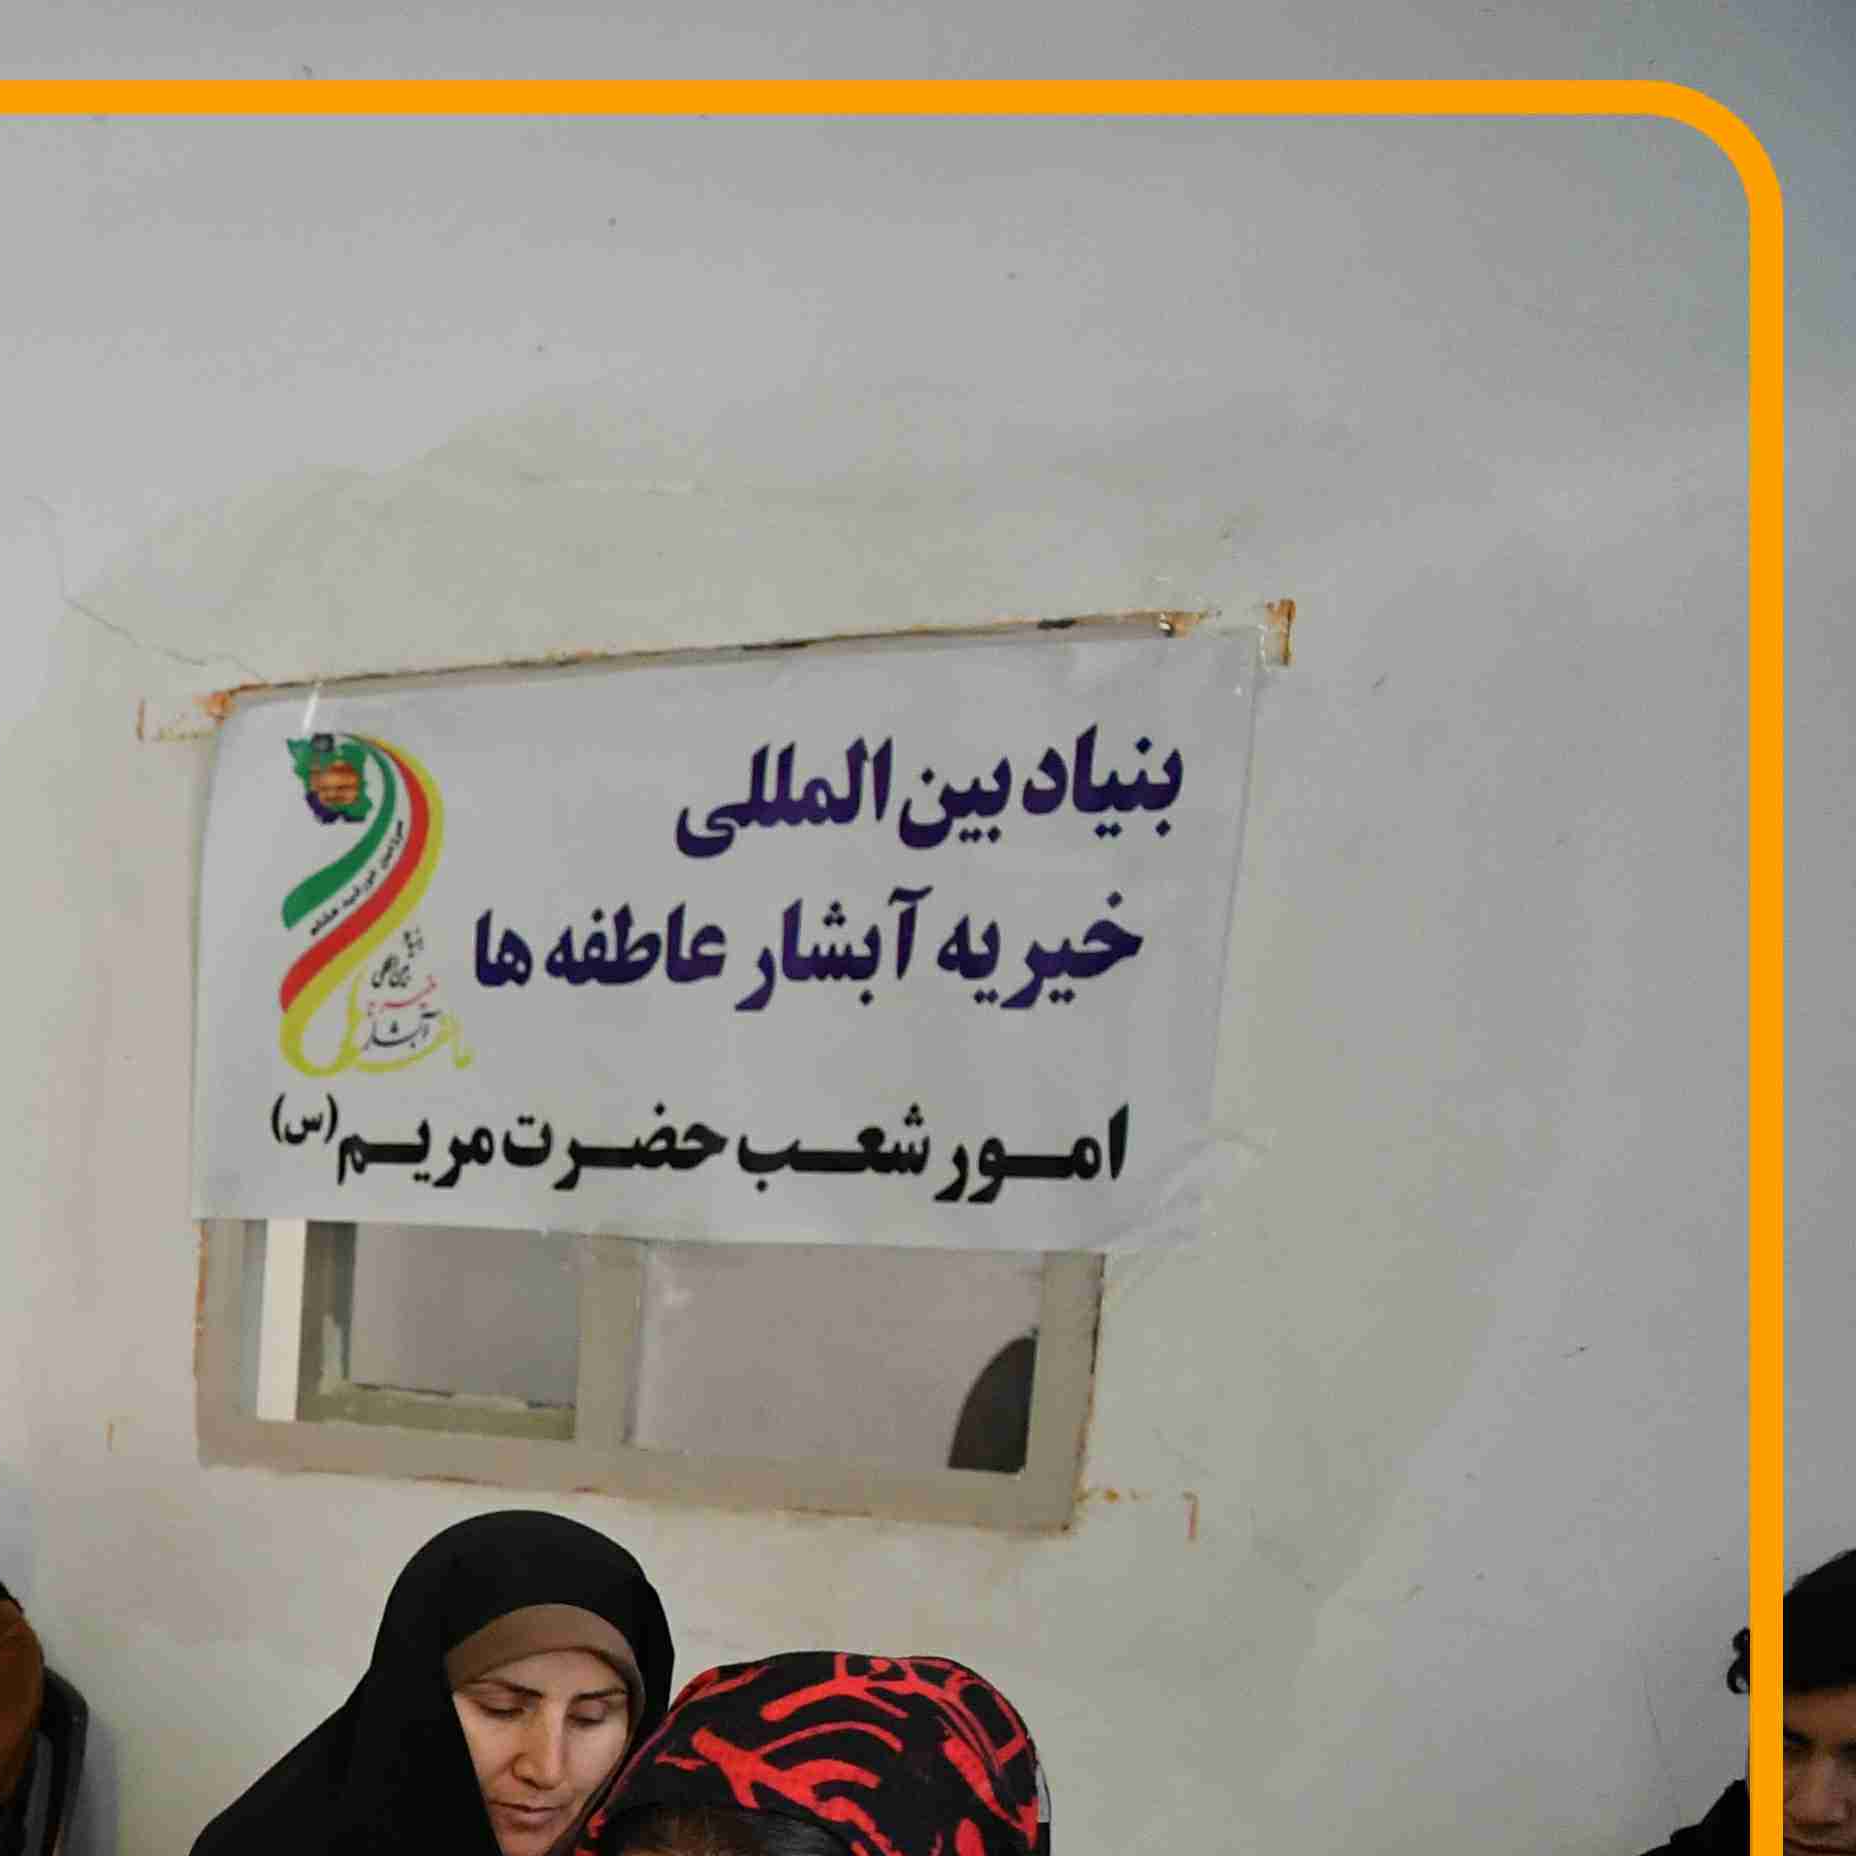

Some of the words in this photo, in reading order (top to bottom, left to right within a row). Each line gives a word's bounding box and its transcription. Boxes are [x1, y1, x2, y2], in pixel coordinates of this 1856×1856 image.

[674, 736, 894, 860] المللی
[897, 755, 1014, 850] بین
[1020, 722, 1185, 841] بنیاد
[473, 908, 535, 989] ها
[543, 901, 728, 988] عاطفه
[732, 884, 935, 1013] آبشار
[935, 889, 1146, 1012] خیریه
[270, 1092, 339, 1146] (س)
[337, 1116, 496, 1190] مریم
[501, 1102, 730, 1193] حضرت
[736, 1102, 932, 1194] شعب
[932, 1102, 1130, 1206] امور
